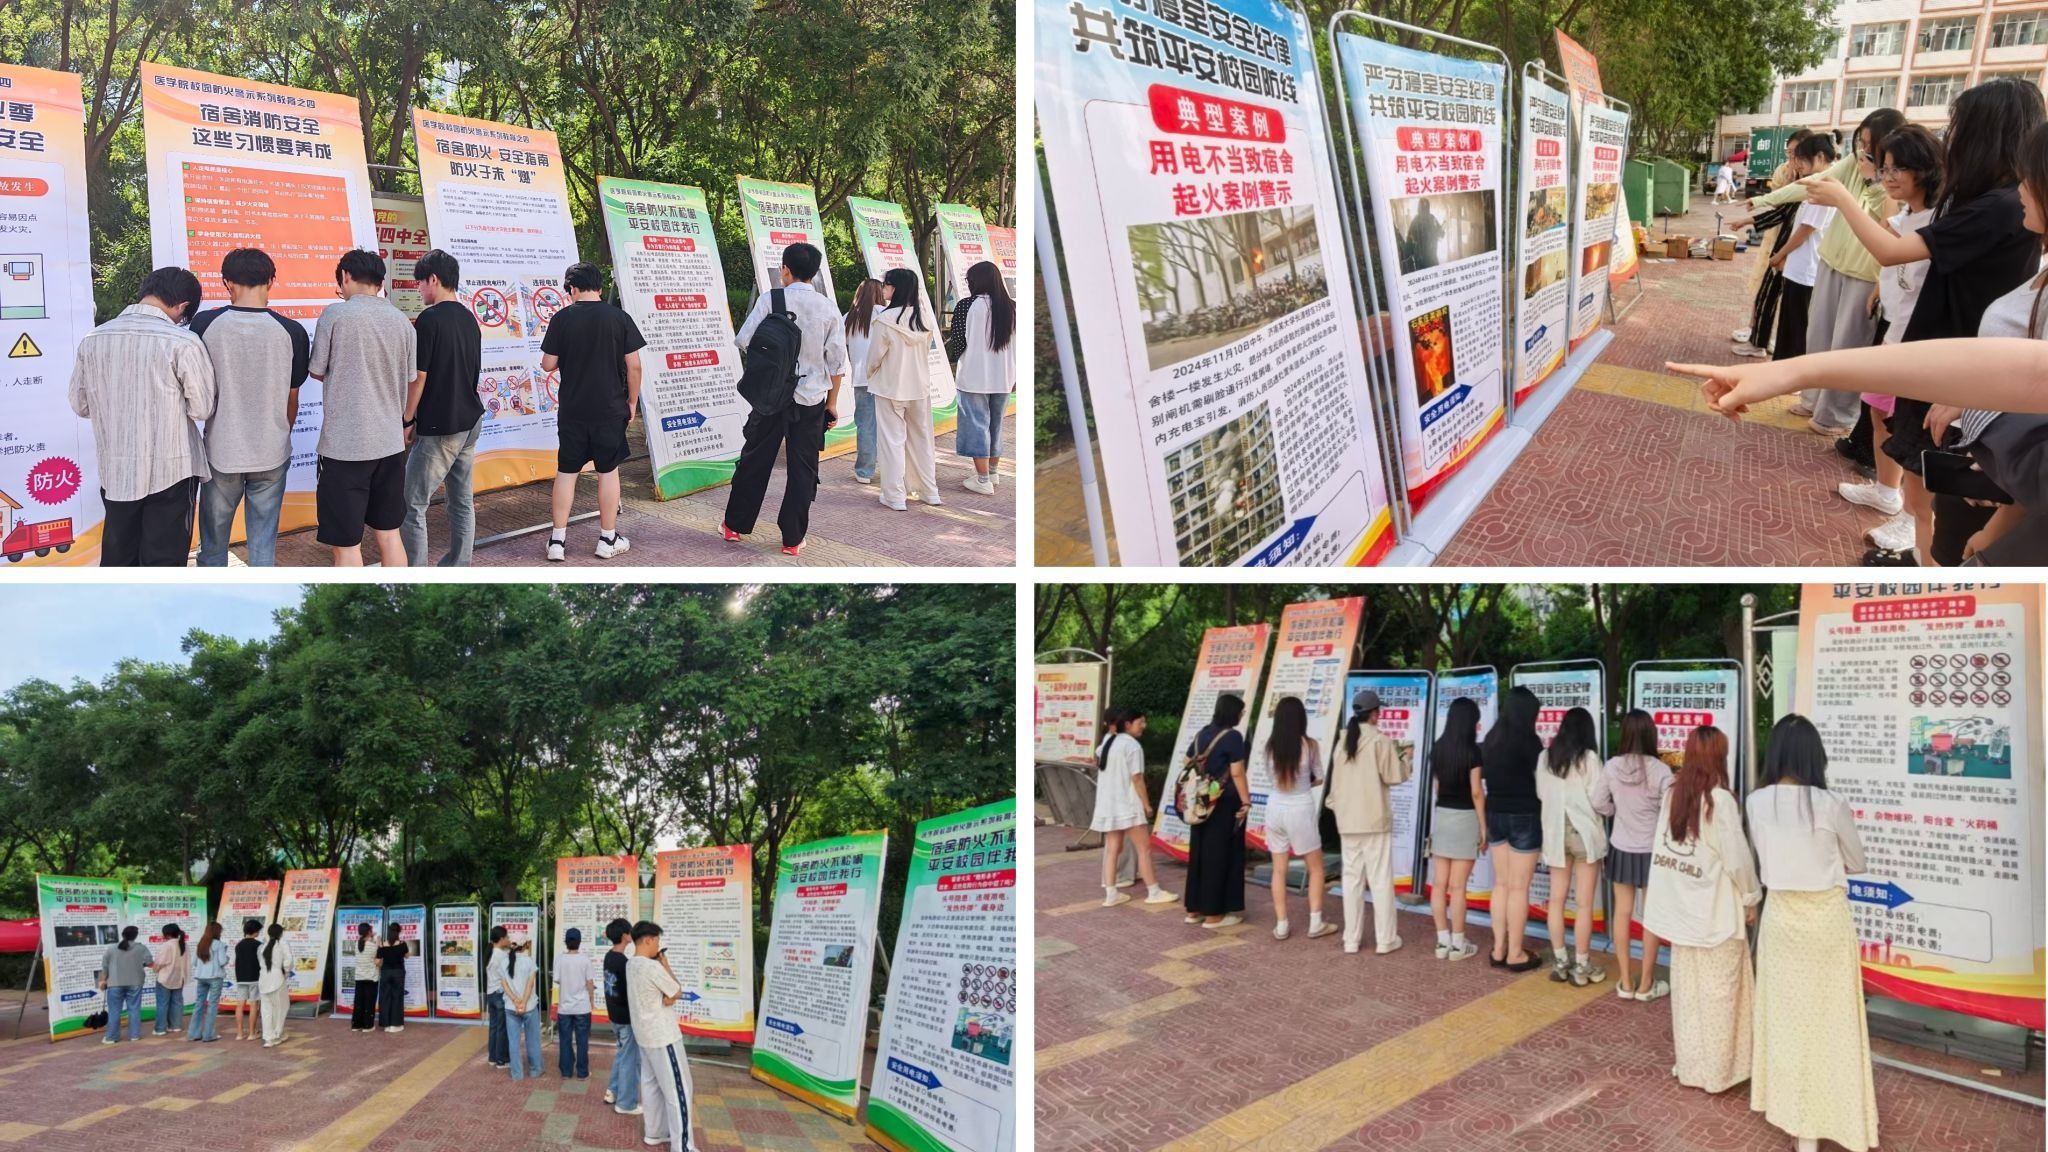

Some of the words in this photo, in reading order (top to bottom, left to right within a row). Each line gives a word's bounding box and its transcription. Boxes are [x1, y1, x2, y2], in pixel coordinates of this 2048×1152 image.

[1070, 3, 1298, 104] 共筑平安校园防线
[1363, 63, 1495, 101] 严守寝室安全纪律
[0, 101, 34, 123] 季
[199, 103, 321, 136] 宿舍消防安全
[1176, 95, 1271, 139] 典型案例
[1369, 94, 1496, 125] 共筑平安校园防线
[0, 129, 45, 152] 安全
[191, 126, 332, 160] 这些习惯要养成
[1411, 131, 1471, 150] 典型案例
[436, 139, 492, 160] 宿舍防火
[499, 148, 550, 167] 安全指南
[1149, 140, 1294, 176] 用电不当致宿舍
[1396, 154, 1486, 174] 用电不当致宿舍
[1405, 174, 1481, 195] 起火案例警示
[1173, 180, 1293, 217] 起火案例警示
[33, 470, 75, 492] 防火
[1642, 683, 1727, 695] 严守寝室安全纪律
[1642, 697, 1726, 710] 共筑平安校园防线
[1653, 854, 1678, 871] DEAR
[1846, 884, 1894, 902] 电须知：
